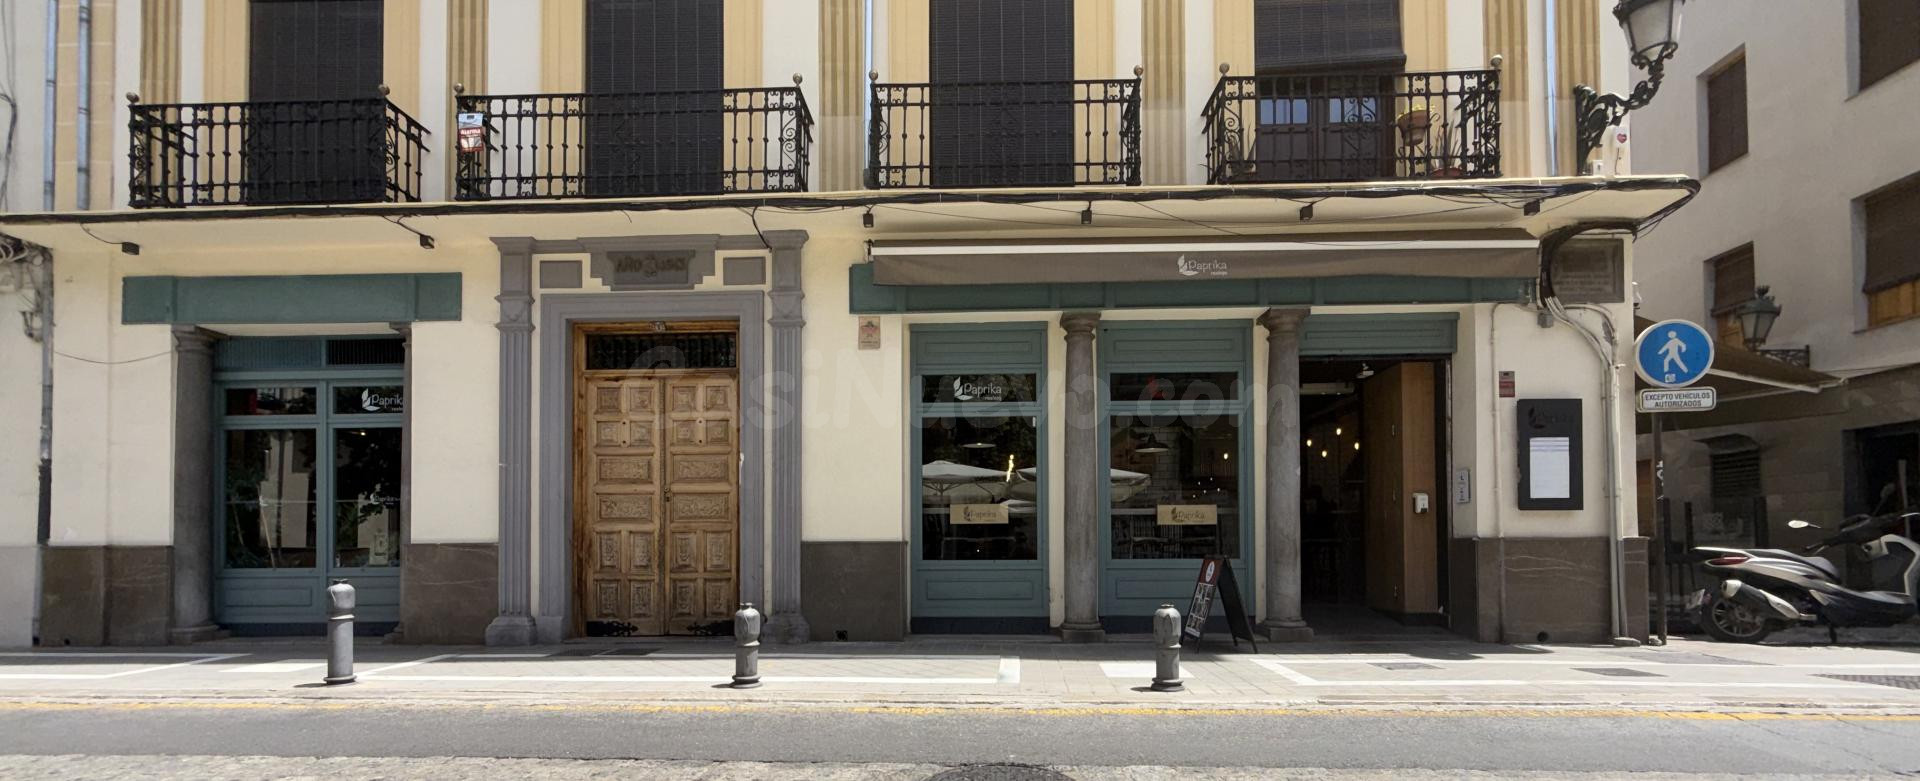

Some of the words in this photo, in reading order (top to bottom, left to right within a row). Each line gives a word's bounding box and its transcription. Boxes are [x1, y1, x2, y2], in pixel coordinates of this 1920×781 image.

[1188, 259, 1227, 273] Paprika
[964, 382, 1002, 397] Paprika
[371, 393, 403, 409] Paprik
[1645, 393, 1673, 401] EXCEPTO
[1654, 399, 1702, 408] AUTORIZADOS
